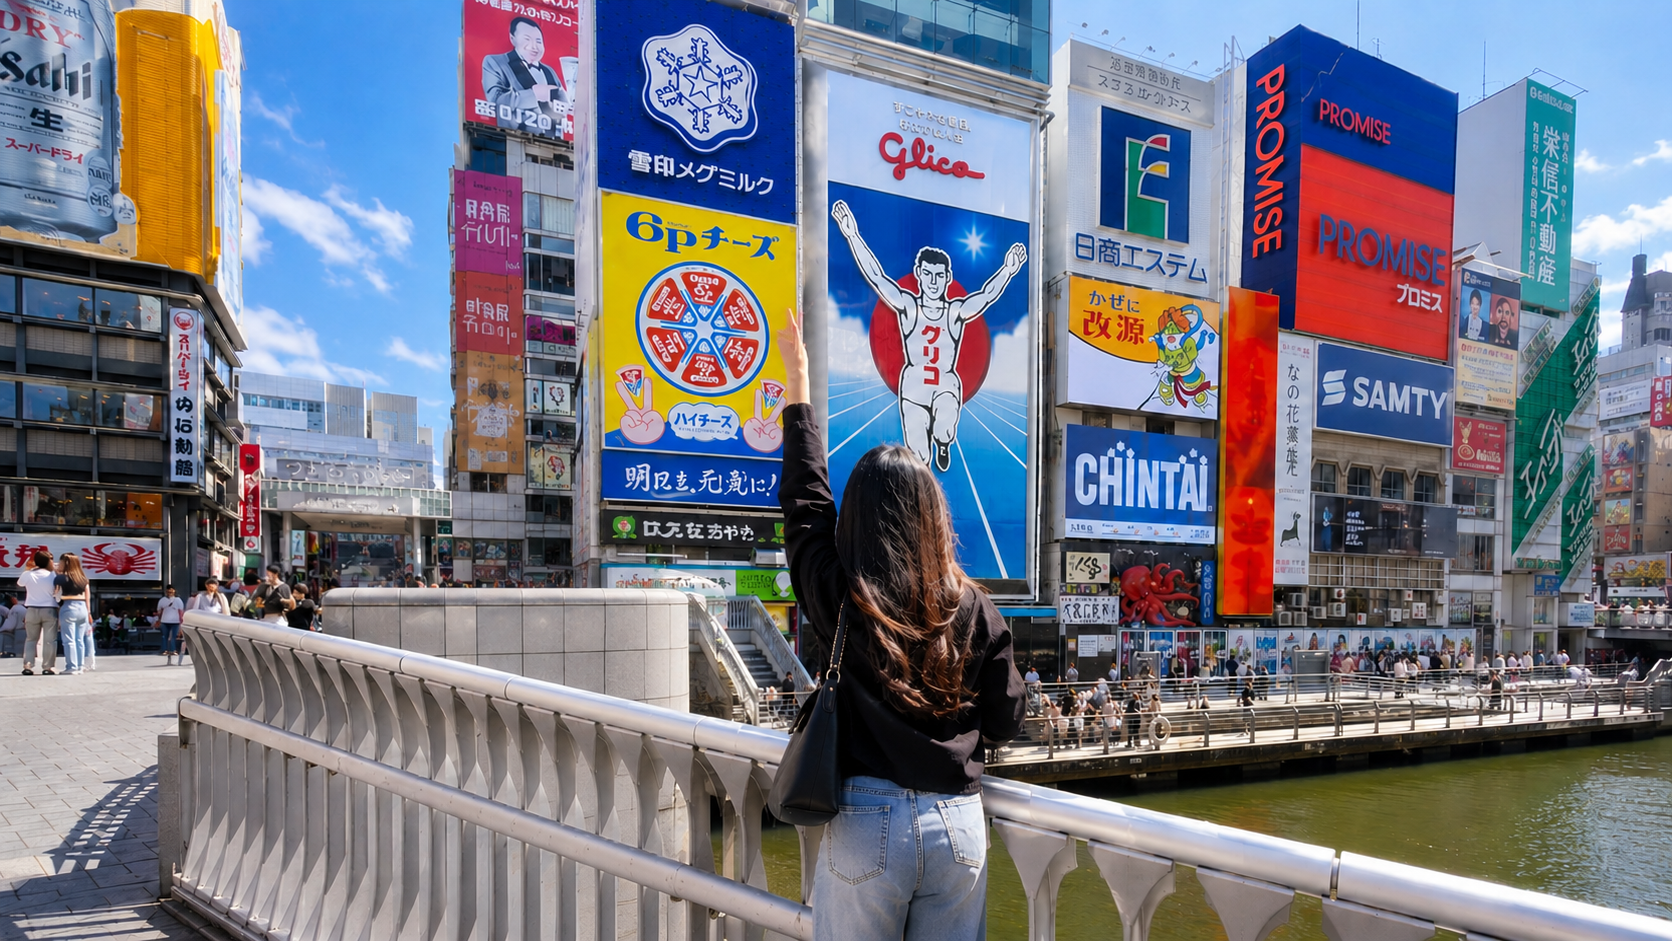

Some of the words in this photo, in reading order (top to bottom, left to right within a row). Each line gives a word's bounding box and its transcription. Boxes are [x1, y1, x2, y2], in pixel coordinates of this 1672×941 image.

[30, 107, 64, 133] 生
[1319, 98, 1391, 145] PROMISE
[5, 137, 84, 165] スーパードライ
[628, 149, 774, 195] 雪印メグミルク
[879, 132, 985, 180] Glico
[1252, 63, 1285, 259] PROMISE
[1075, 232, 1208, 284] 日商エステム
[1319, 213, 1447, 287] PROMISE
[1089, 290, 1141, 313] かぜに
[1396, 283, 1443, 314] プロミス
[1083, 309, 1145, 345] 改源
[1352, 376, 1448, 420] SAMTY
[674, 413, 733, 429] ハイチーズ
[1074, 451, 1208, 512] CHINTAI
